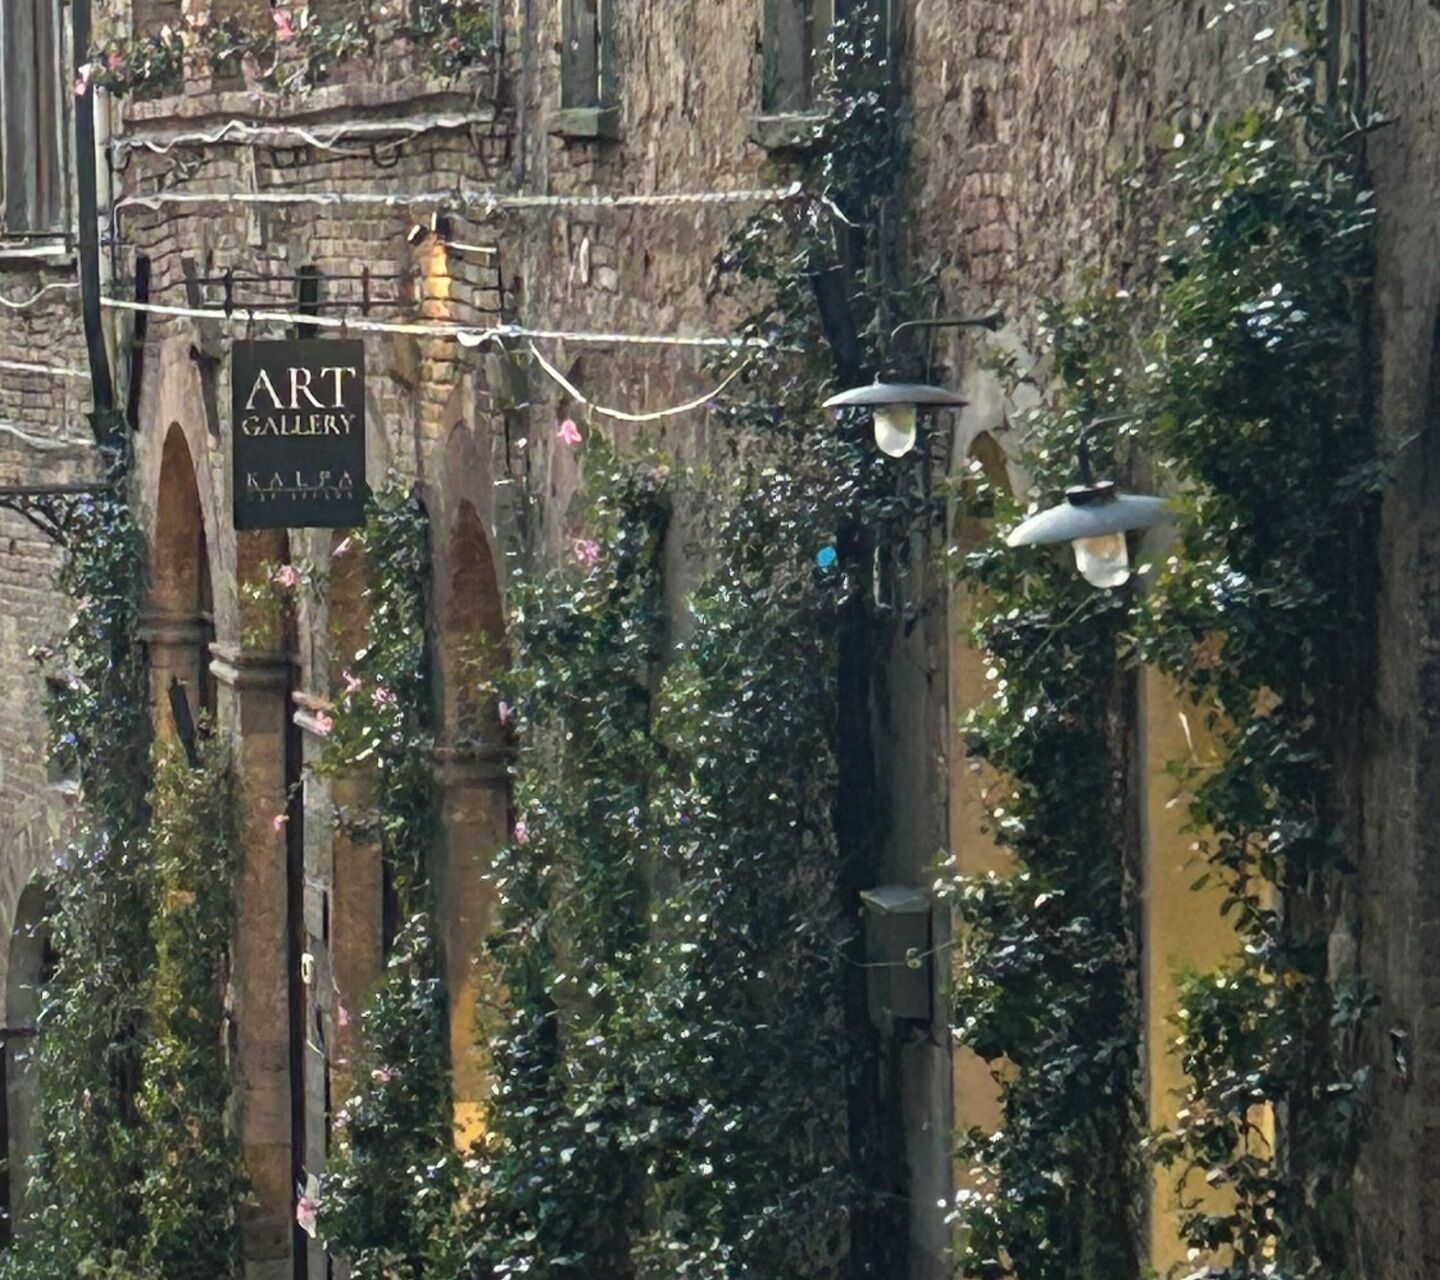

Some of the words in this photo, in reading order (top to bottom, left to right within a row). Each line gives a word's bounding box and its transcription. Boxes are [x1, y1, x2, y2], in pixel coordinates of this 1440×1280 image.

[245, 366, 357, 410] ART
[241, 414, 357, 436] GALLERY
[246, 470, 353, 488] KALPA
